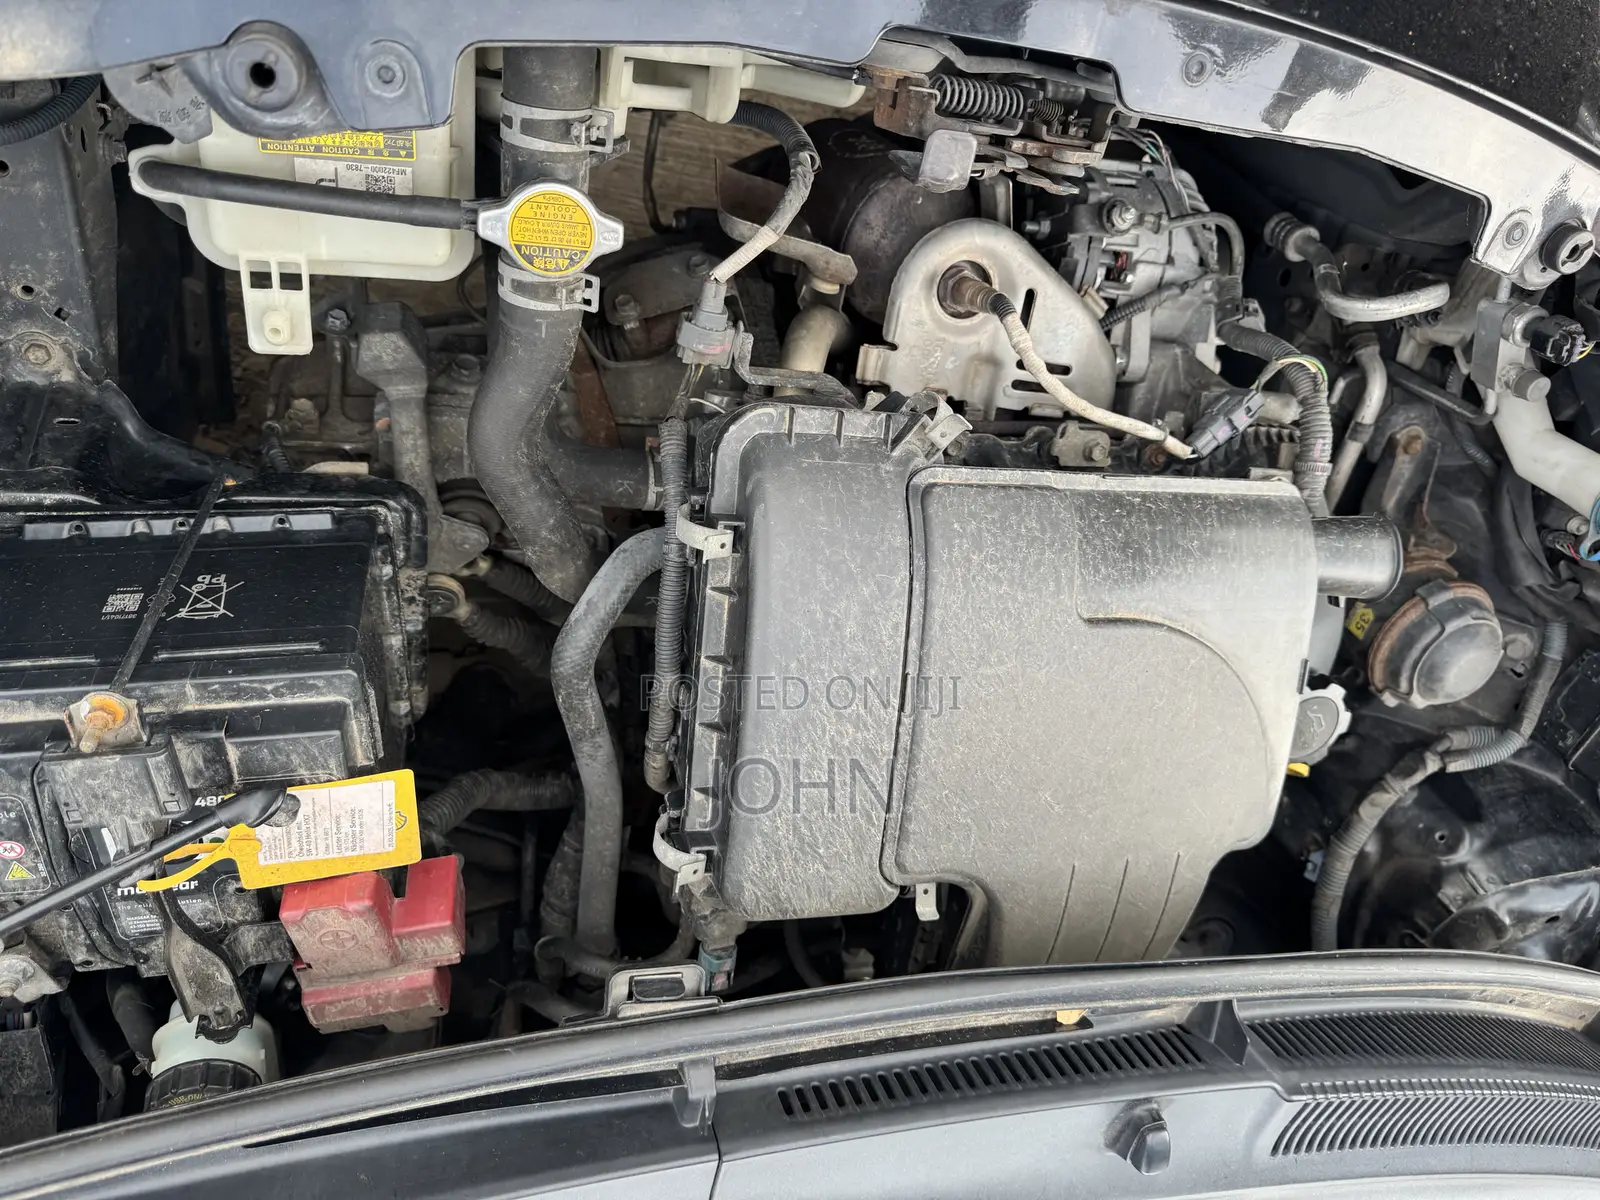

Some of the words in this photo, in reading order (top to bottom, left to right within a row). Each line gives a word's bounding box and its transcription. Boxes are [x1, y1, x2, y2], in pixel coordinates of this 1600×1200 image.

[267, 143, 314, 152] ATTENTION
[322, 146, 360, 155] CAUTION
[529, 204, 577, 213] COOLANT
[532, 211, 573, 220] ENGINE
[521, 245, 580, 259] CAUTION
[197, 574, 226, 584] Pb
[348, 805, 356, 828] Service:
[333, 813, 341, 835] Service:
[334, 835, 342, 854] Letzter
[349, 829, 357, 852] Nächster
